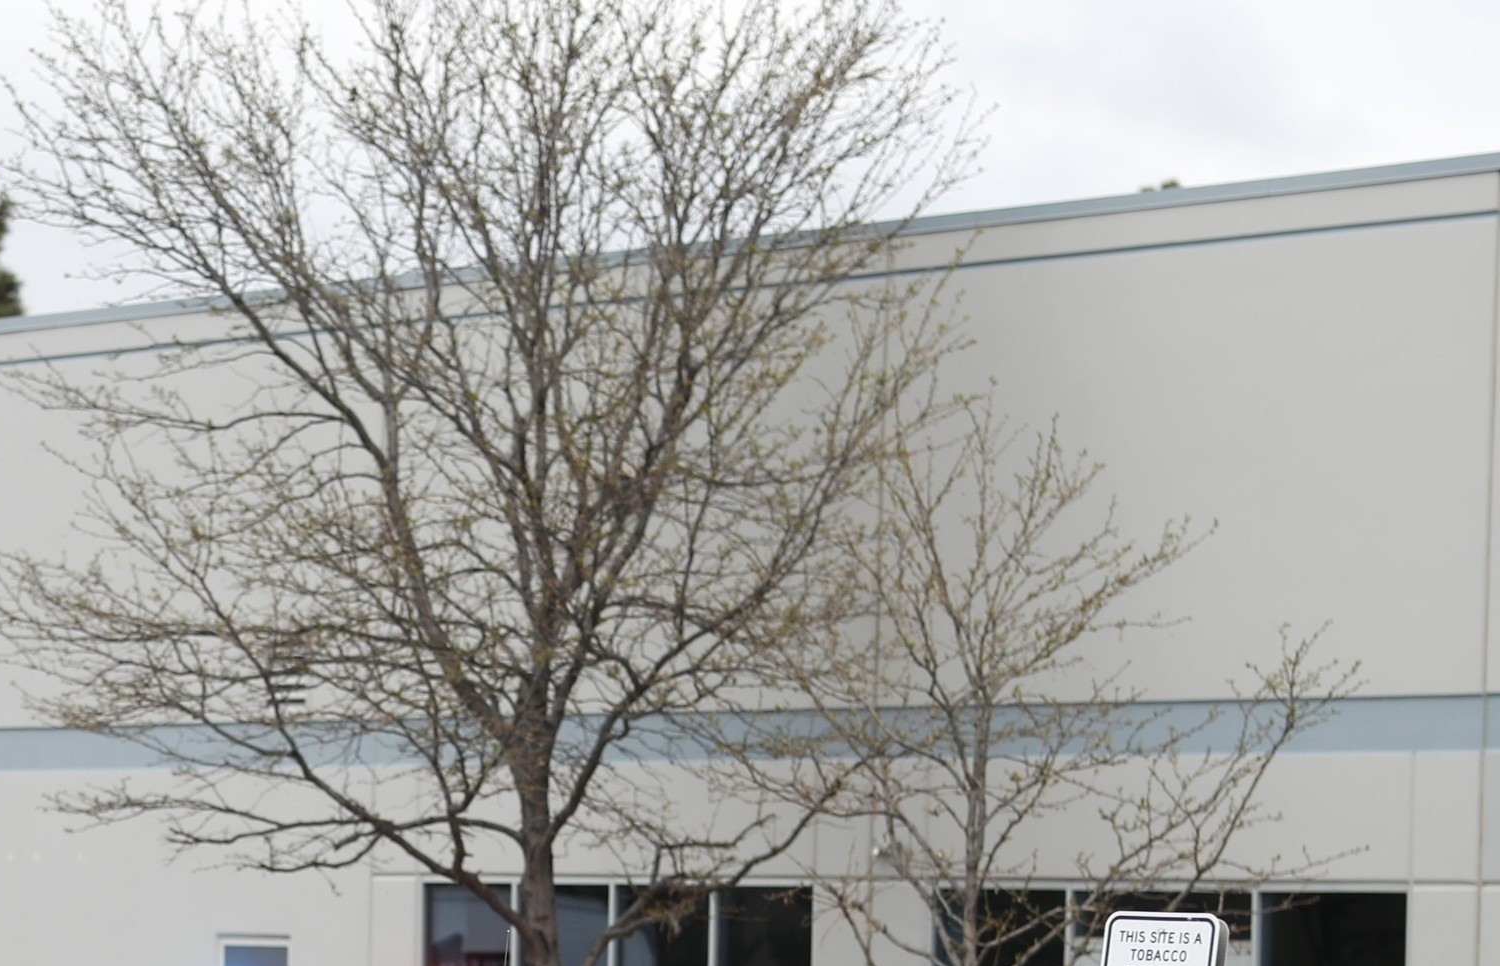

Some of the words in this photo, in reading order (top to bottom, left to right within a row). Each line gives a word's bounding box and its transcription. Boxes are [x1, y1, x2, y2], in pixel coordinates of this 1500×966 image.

[1120, 930, 1145, 943] THIS
[1150, 931, 1175, 944] SITE
[1179, 932, 1190, 944] IS
[1194, 933, 1202, 944] A
[1131, 949, 1187, 962] TOBACCO
